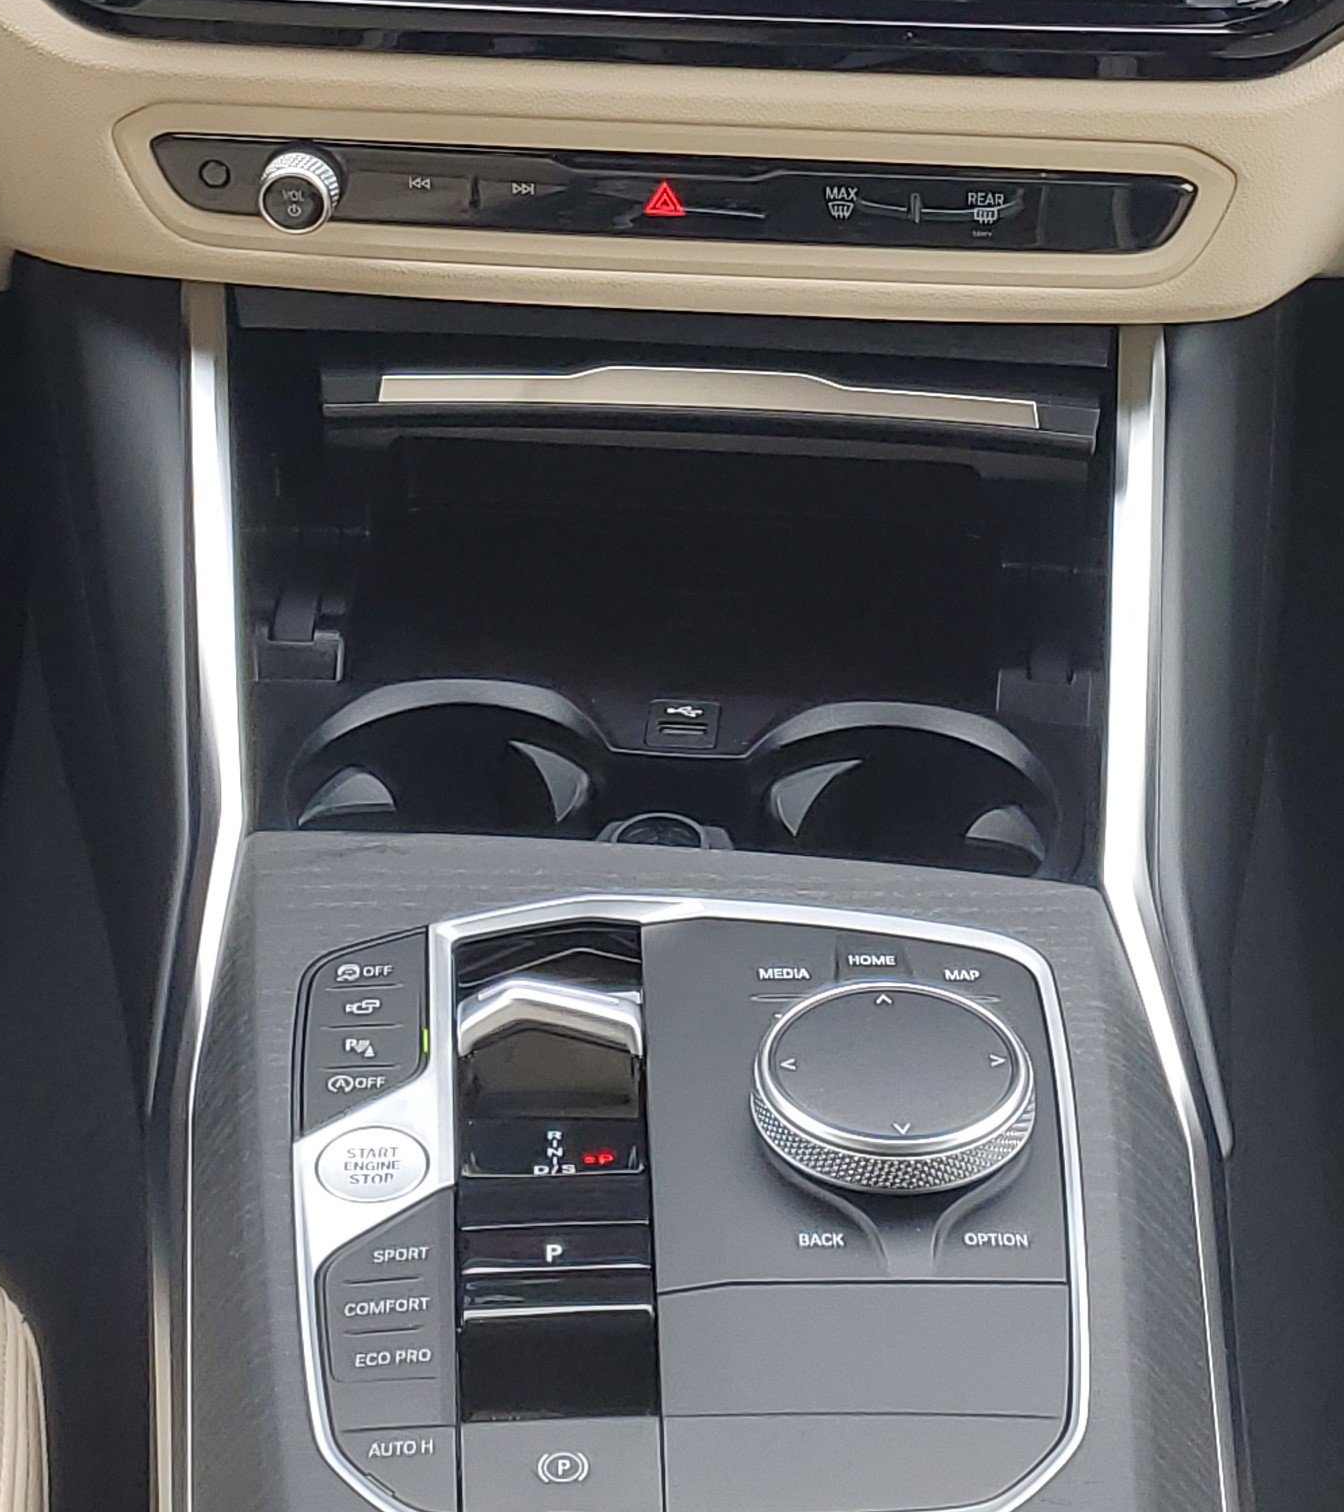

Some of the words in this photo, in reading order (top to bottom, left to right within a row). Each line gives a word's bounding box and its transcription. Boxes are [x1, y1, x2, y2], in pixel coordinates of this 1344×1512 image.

[281, 189, 305, 202] VOL
[825, 186, 858, 202] MAX
[968, 192, 1004, 206] REAR
[847, 953, 896, 967] HOME
[363, 964, 394, 977] OFF
[759, 966, 810, 981] MEDIA
[944, 968, 980, 982] MAP
[355, 1076, 386, 1089] OFF
[347, 1146, 399, 1159] START
[344, 1159, 401, 1172] ENGINE
[349, 1173, 395, 1185] STOP
[798, 1232, 845, 1249] BACK
[964, 1231, 1029, 1248] OPTION
[373, 1246, 430, 1264] SPORT
[545, 1244, 564, 1263] P
[344, 1297, 431, 1317] COMFORT
[355, 1351, 391, 1368] ECO
[395, 1348, 432, 1364] PRO
[368, 1440, 417, 1459] AUTO
[421, 1439, 434, 1455] H
